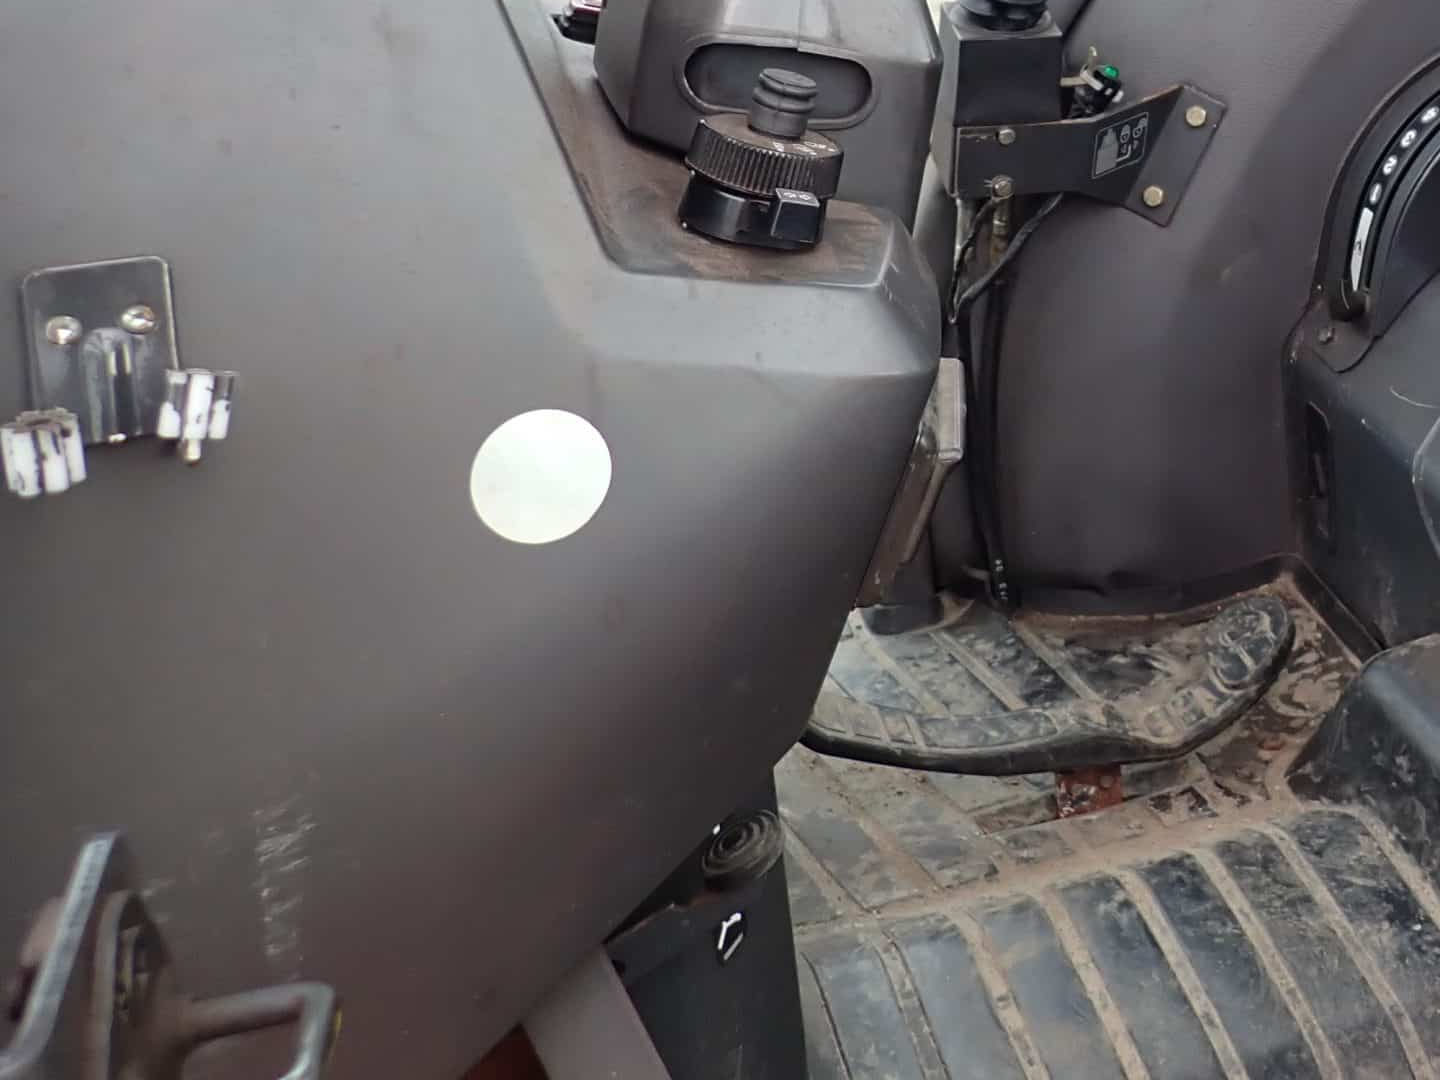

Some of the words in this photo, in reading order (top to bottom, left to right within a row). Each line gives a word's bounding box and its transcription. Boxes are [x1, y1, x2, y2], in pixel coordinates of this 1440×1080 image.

[1401, 129, 1418, 148] 3
[1383, 155, 1398, 175] 2
[1370, 183, 1382, 204] 1
